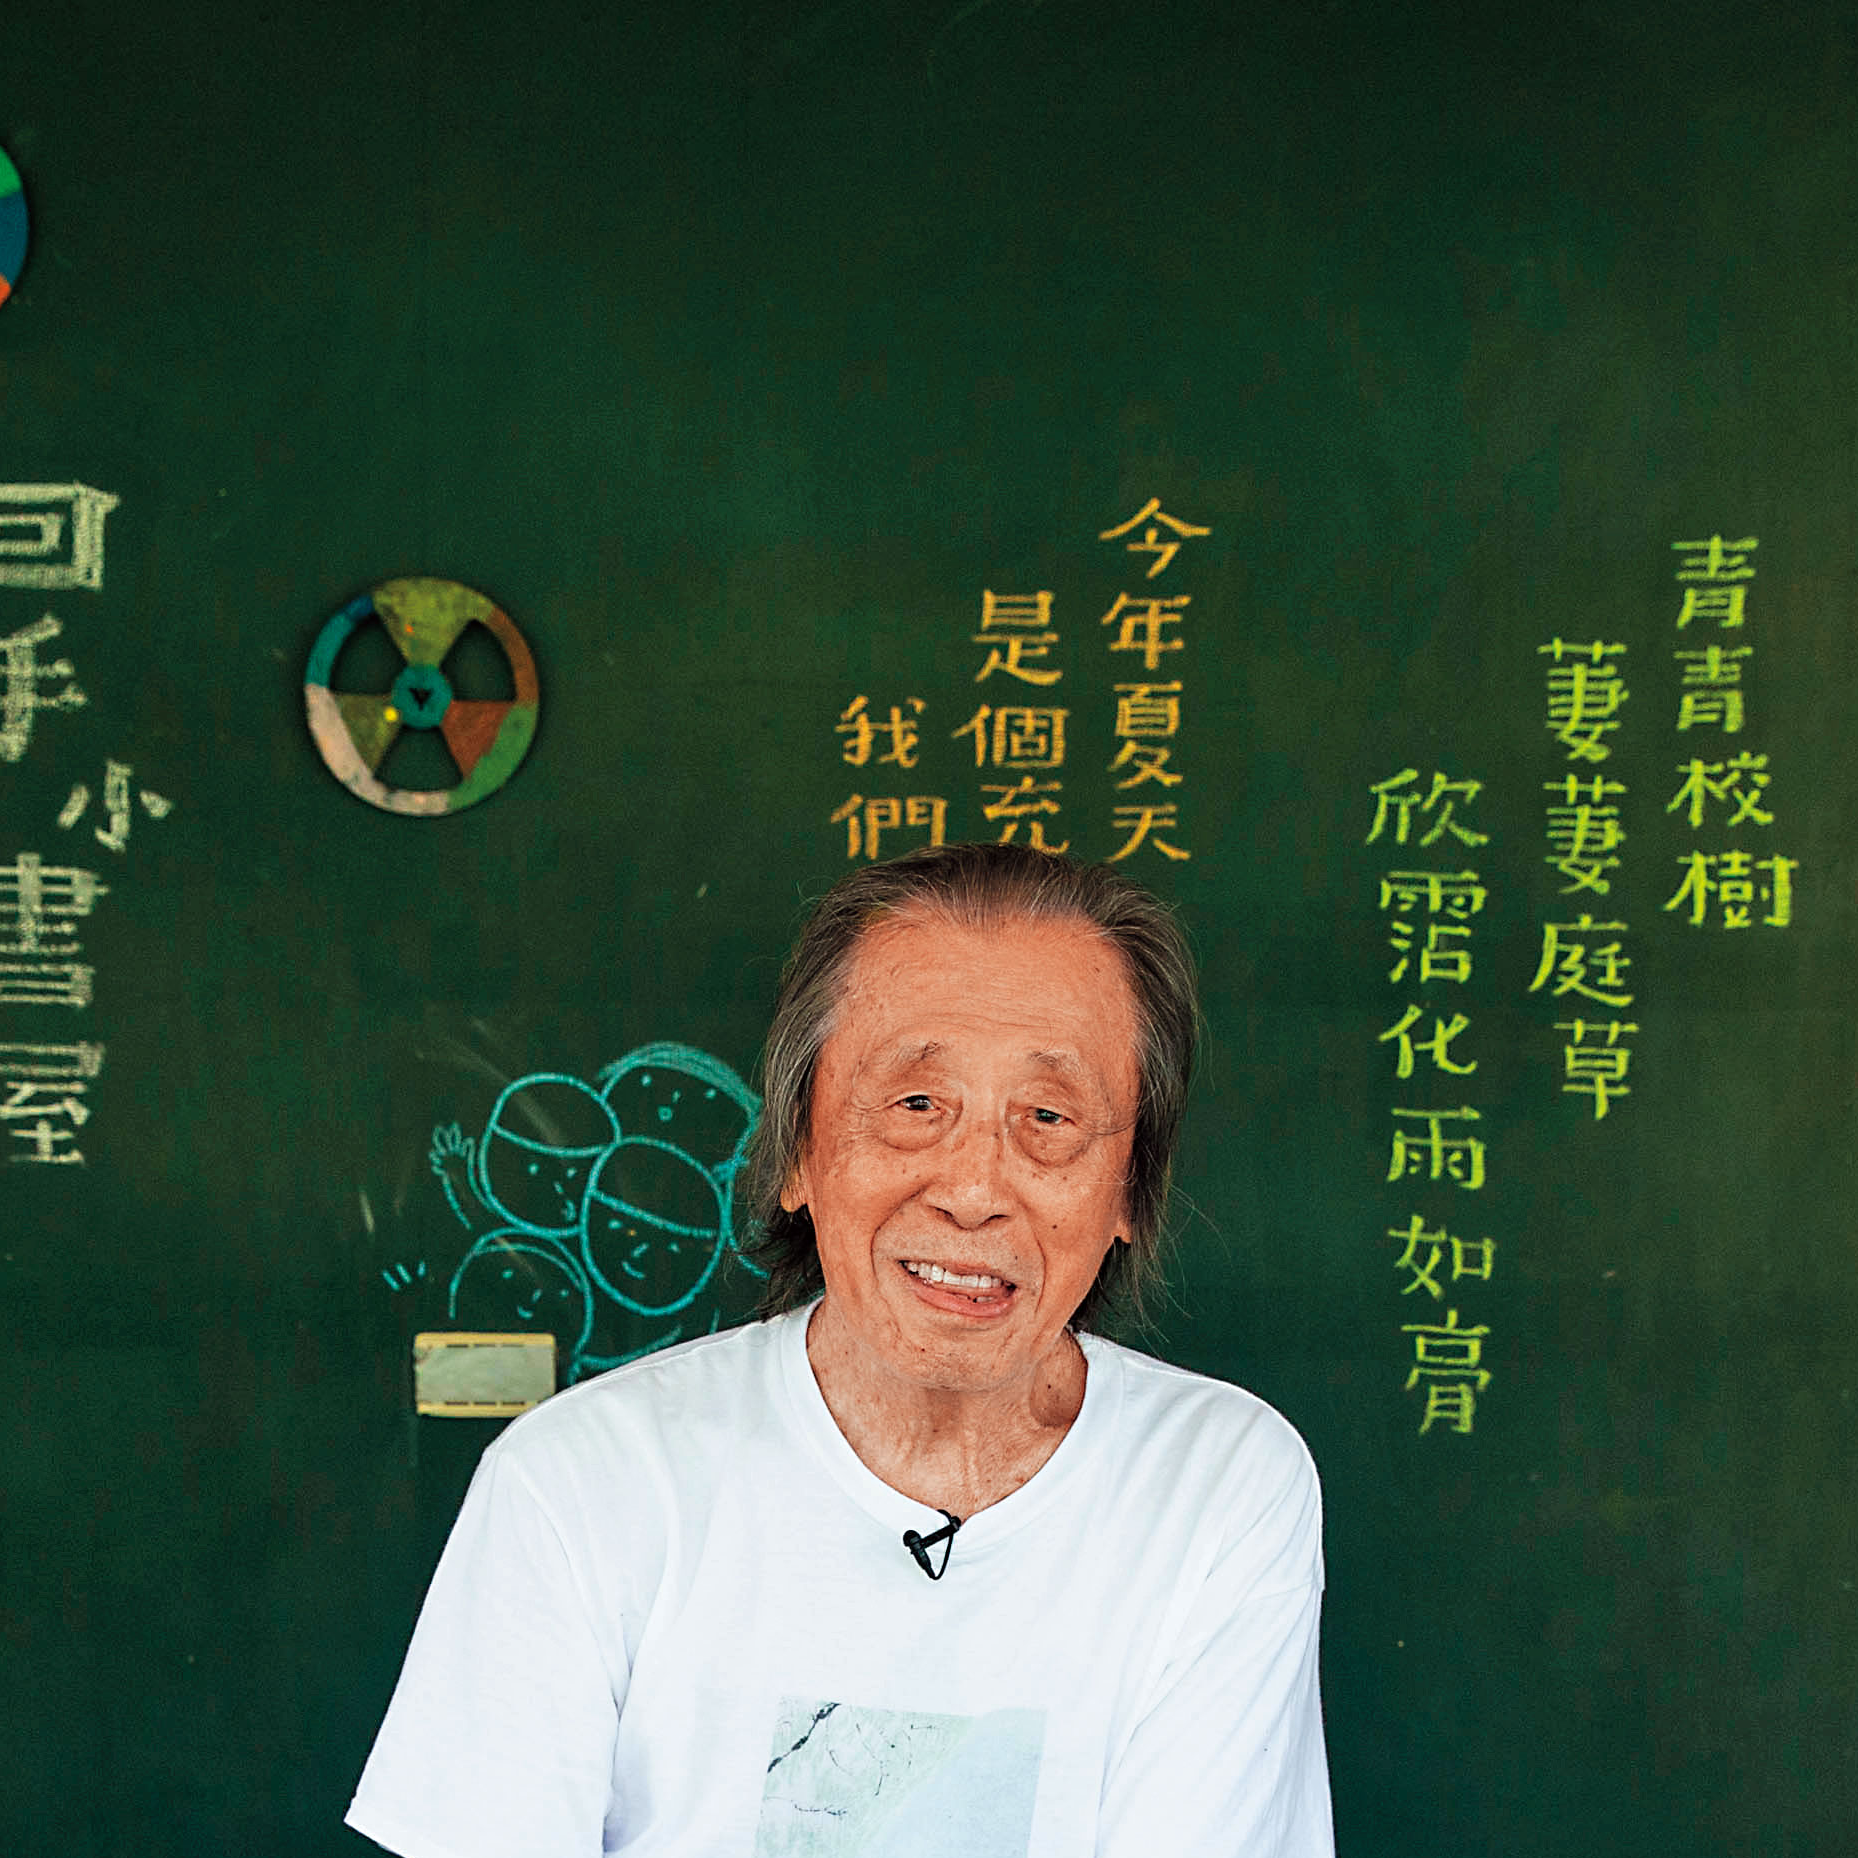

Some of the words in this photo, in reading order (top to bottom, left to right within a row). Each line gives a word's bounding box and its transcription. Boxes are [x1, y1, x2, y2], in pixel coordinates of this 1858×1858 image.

[830, 695, 947, 860] 我們
[1100, 497, 1210, 861] 今年夏天
[1664, 534, 1798, 929] 青青校樹
[1529, 637, 1640, 1121] 萋萋庭草
[1365, 768, 1496, 1433] 欣霑化雨如膏
